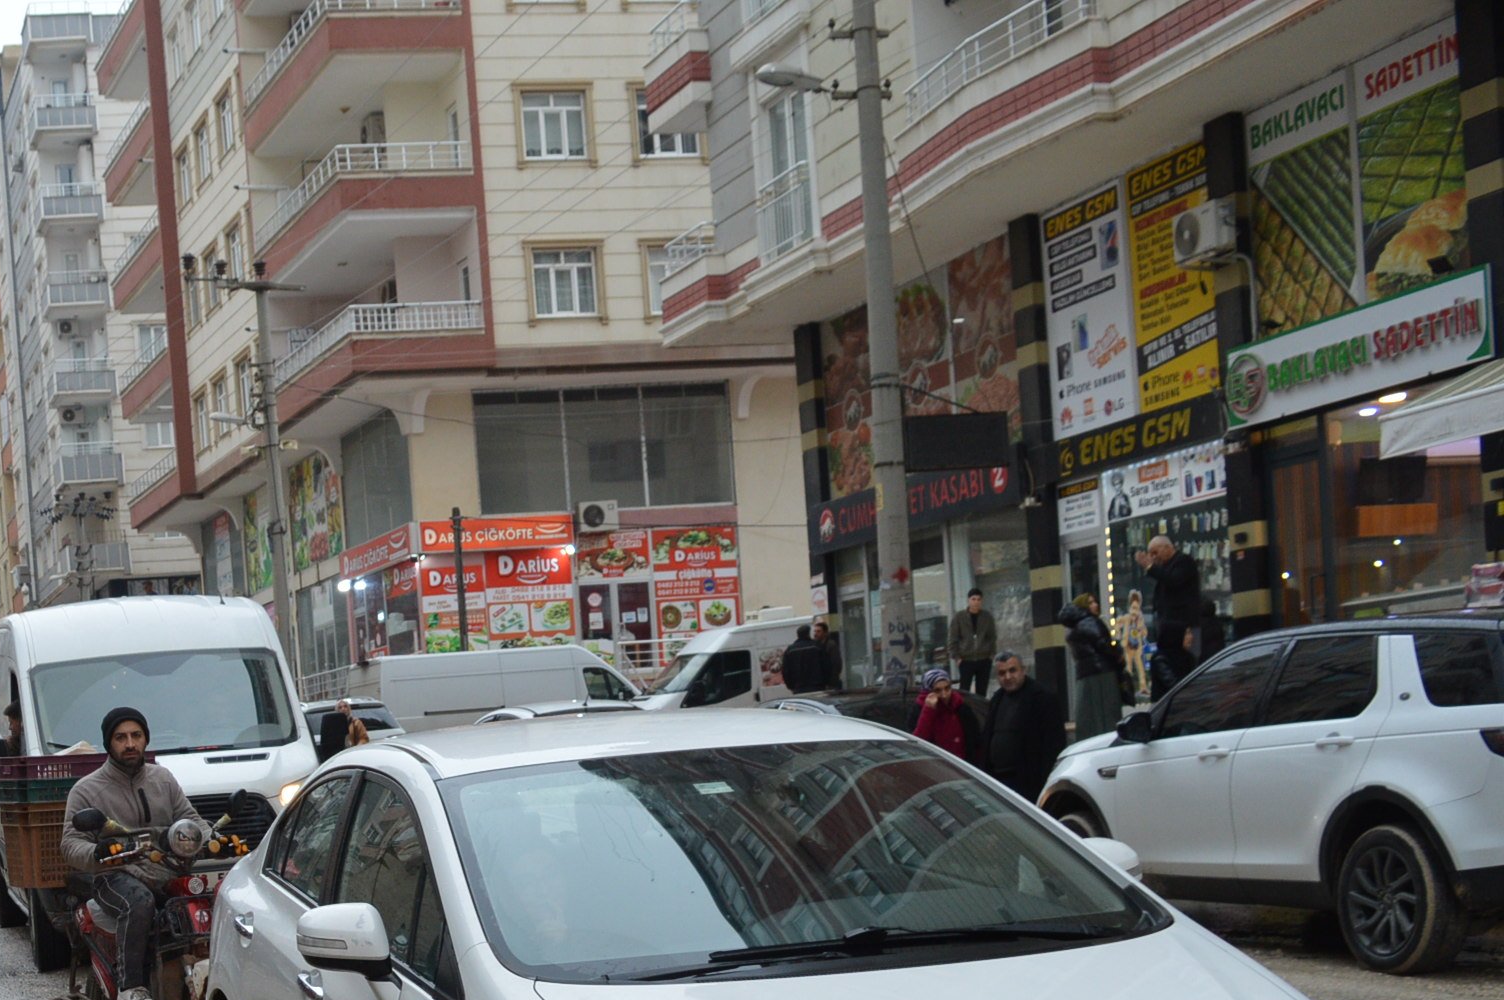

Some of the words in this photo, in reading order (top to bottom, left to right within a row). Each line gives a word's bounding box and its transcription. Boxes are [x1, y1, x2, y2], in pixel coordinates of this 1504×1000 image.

[1364, 34, 1460, 100] SADETTİN
[1250, 84, 1345, 149] BAKLAVACI
[1130, 161, 1172, 196] ENES
[1046, 206, 1082, 238] ENES
[1085, 189, 1116, 220] GSM
[1266, 334, 1368, 394] BAKLAVACI
[1372, 297, 1483, 360] SADETTİN
[1066, 379, 1092, 398] iPhone
[1093, 369, 1126, 388] SAMSUNG
[1144, 387, 1180, 406] SAMSUNG
[1151, 370, 1180, 389] iPhone
[1078, 423, 1137, 466] ENES
[1141, 408, 1192, 449] GSM
[929, 468, 985, 508] KASABI
[424, 527, 472, 546] DARUS
[475, 526, 534, 544] ÇİĞKÖFTE
[498, 554, 560, 576] DARİUS
